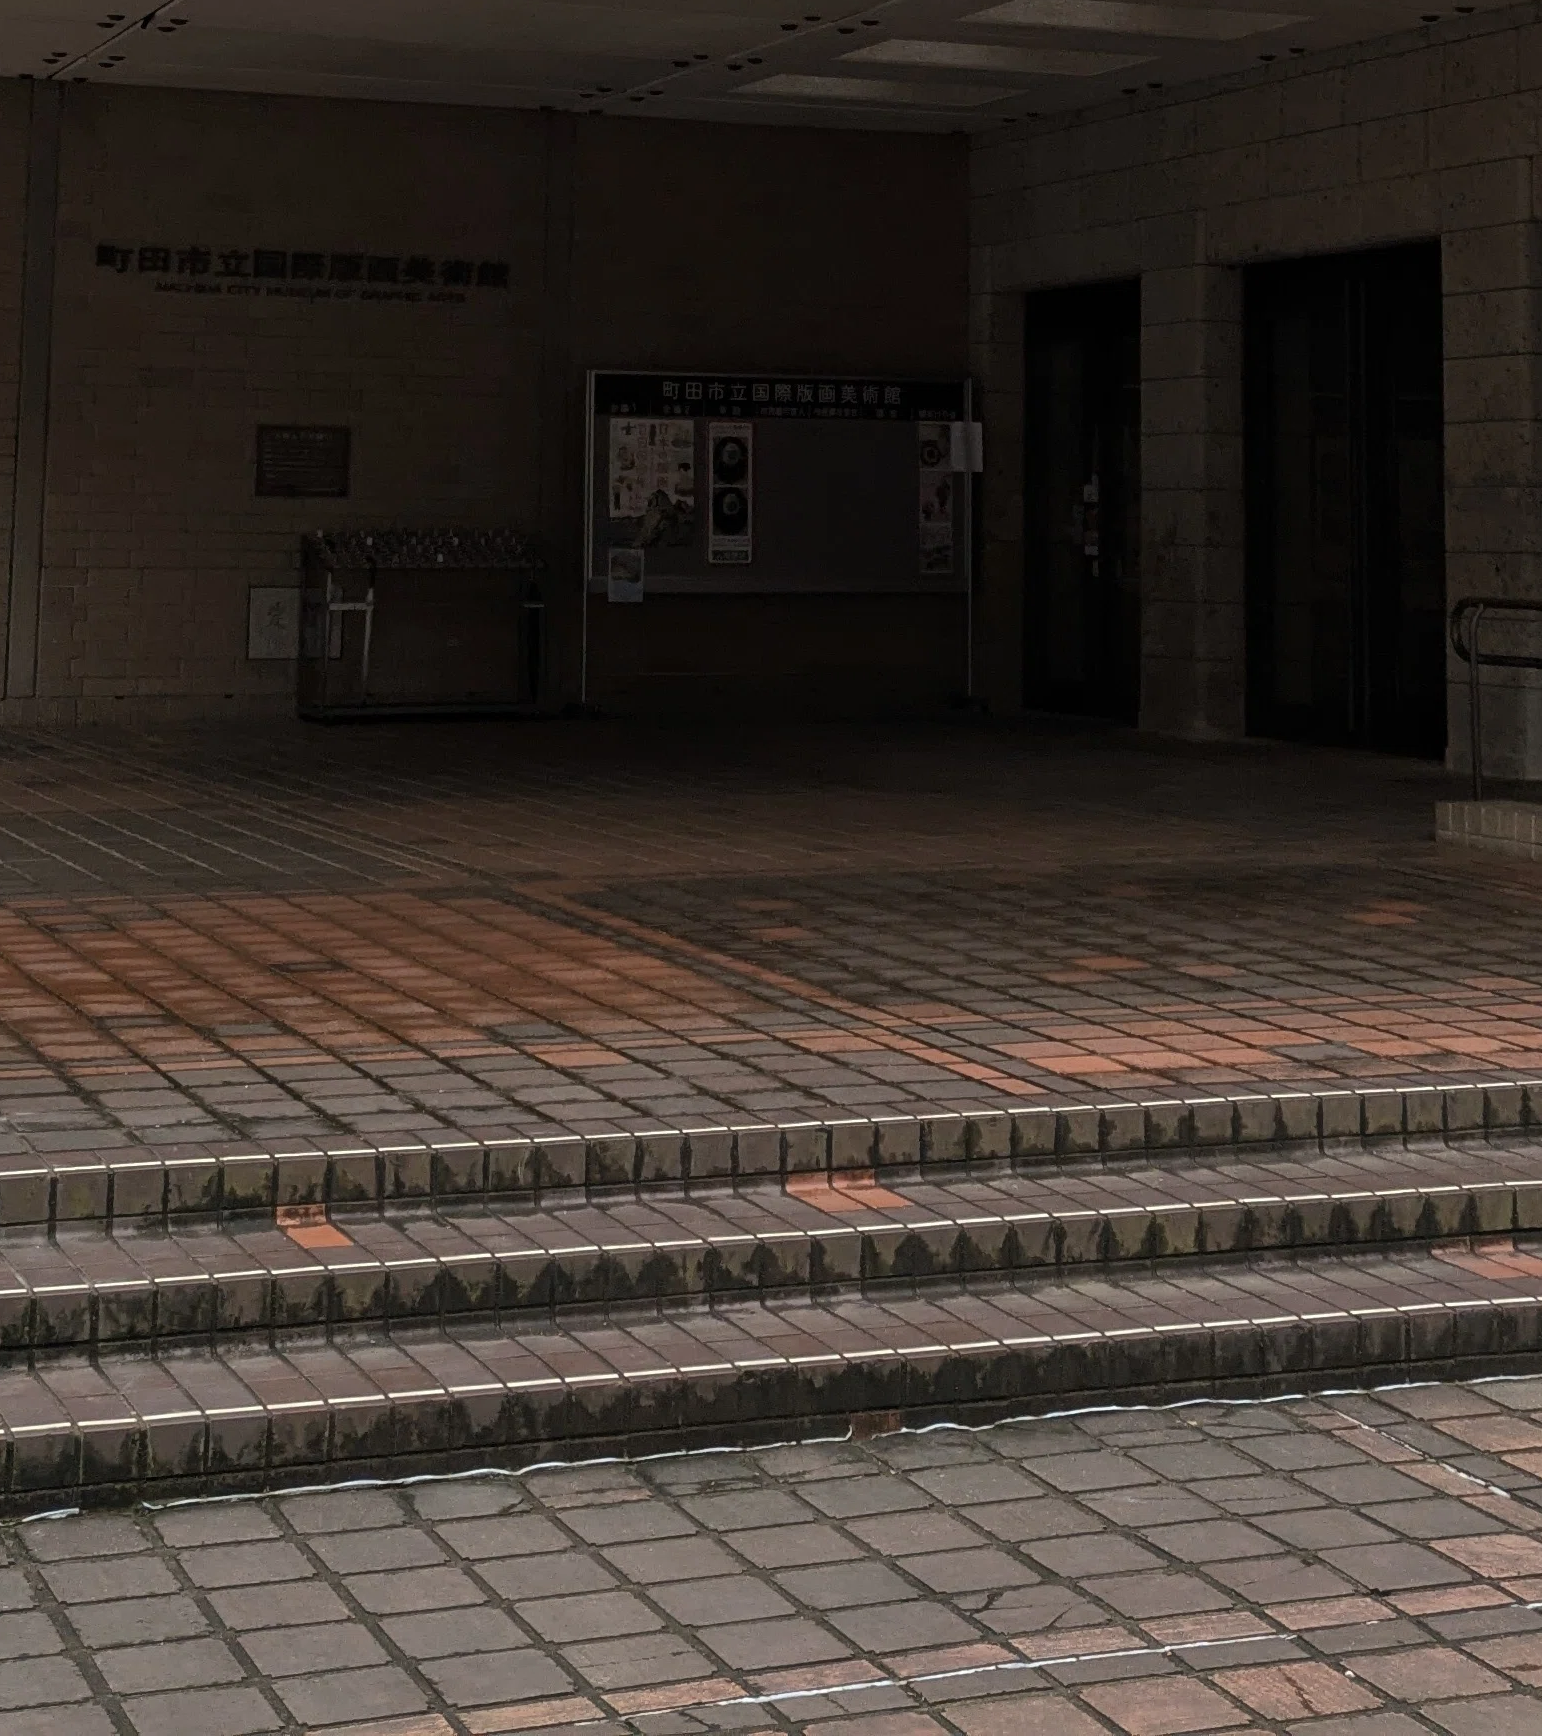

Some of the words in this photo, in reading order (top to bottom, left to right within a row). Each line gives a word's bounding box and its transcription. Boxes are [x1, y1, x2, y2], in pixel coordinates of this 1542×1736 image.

[662, 380, 902, 405] 町田市立国際版画美術館
